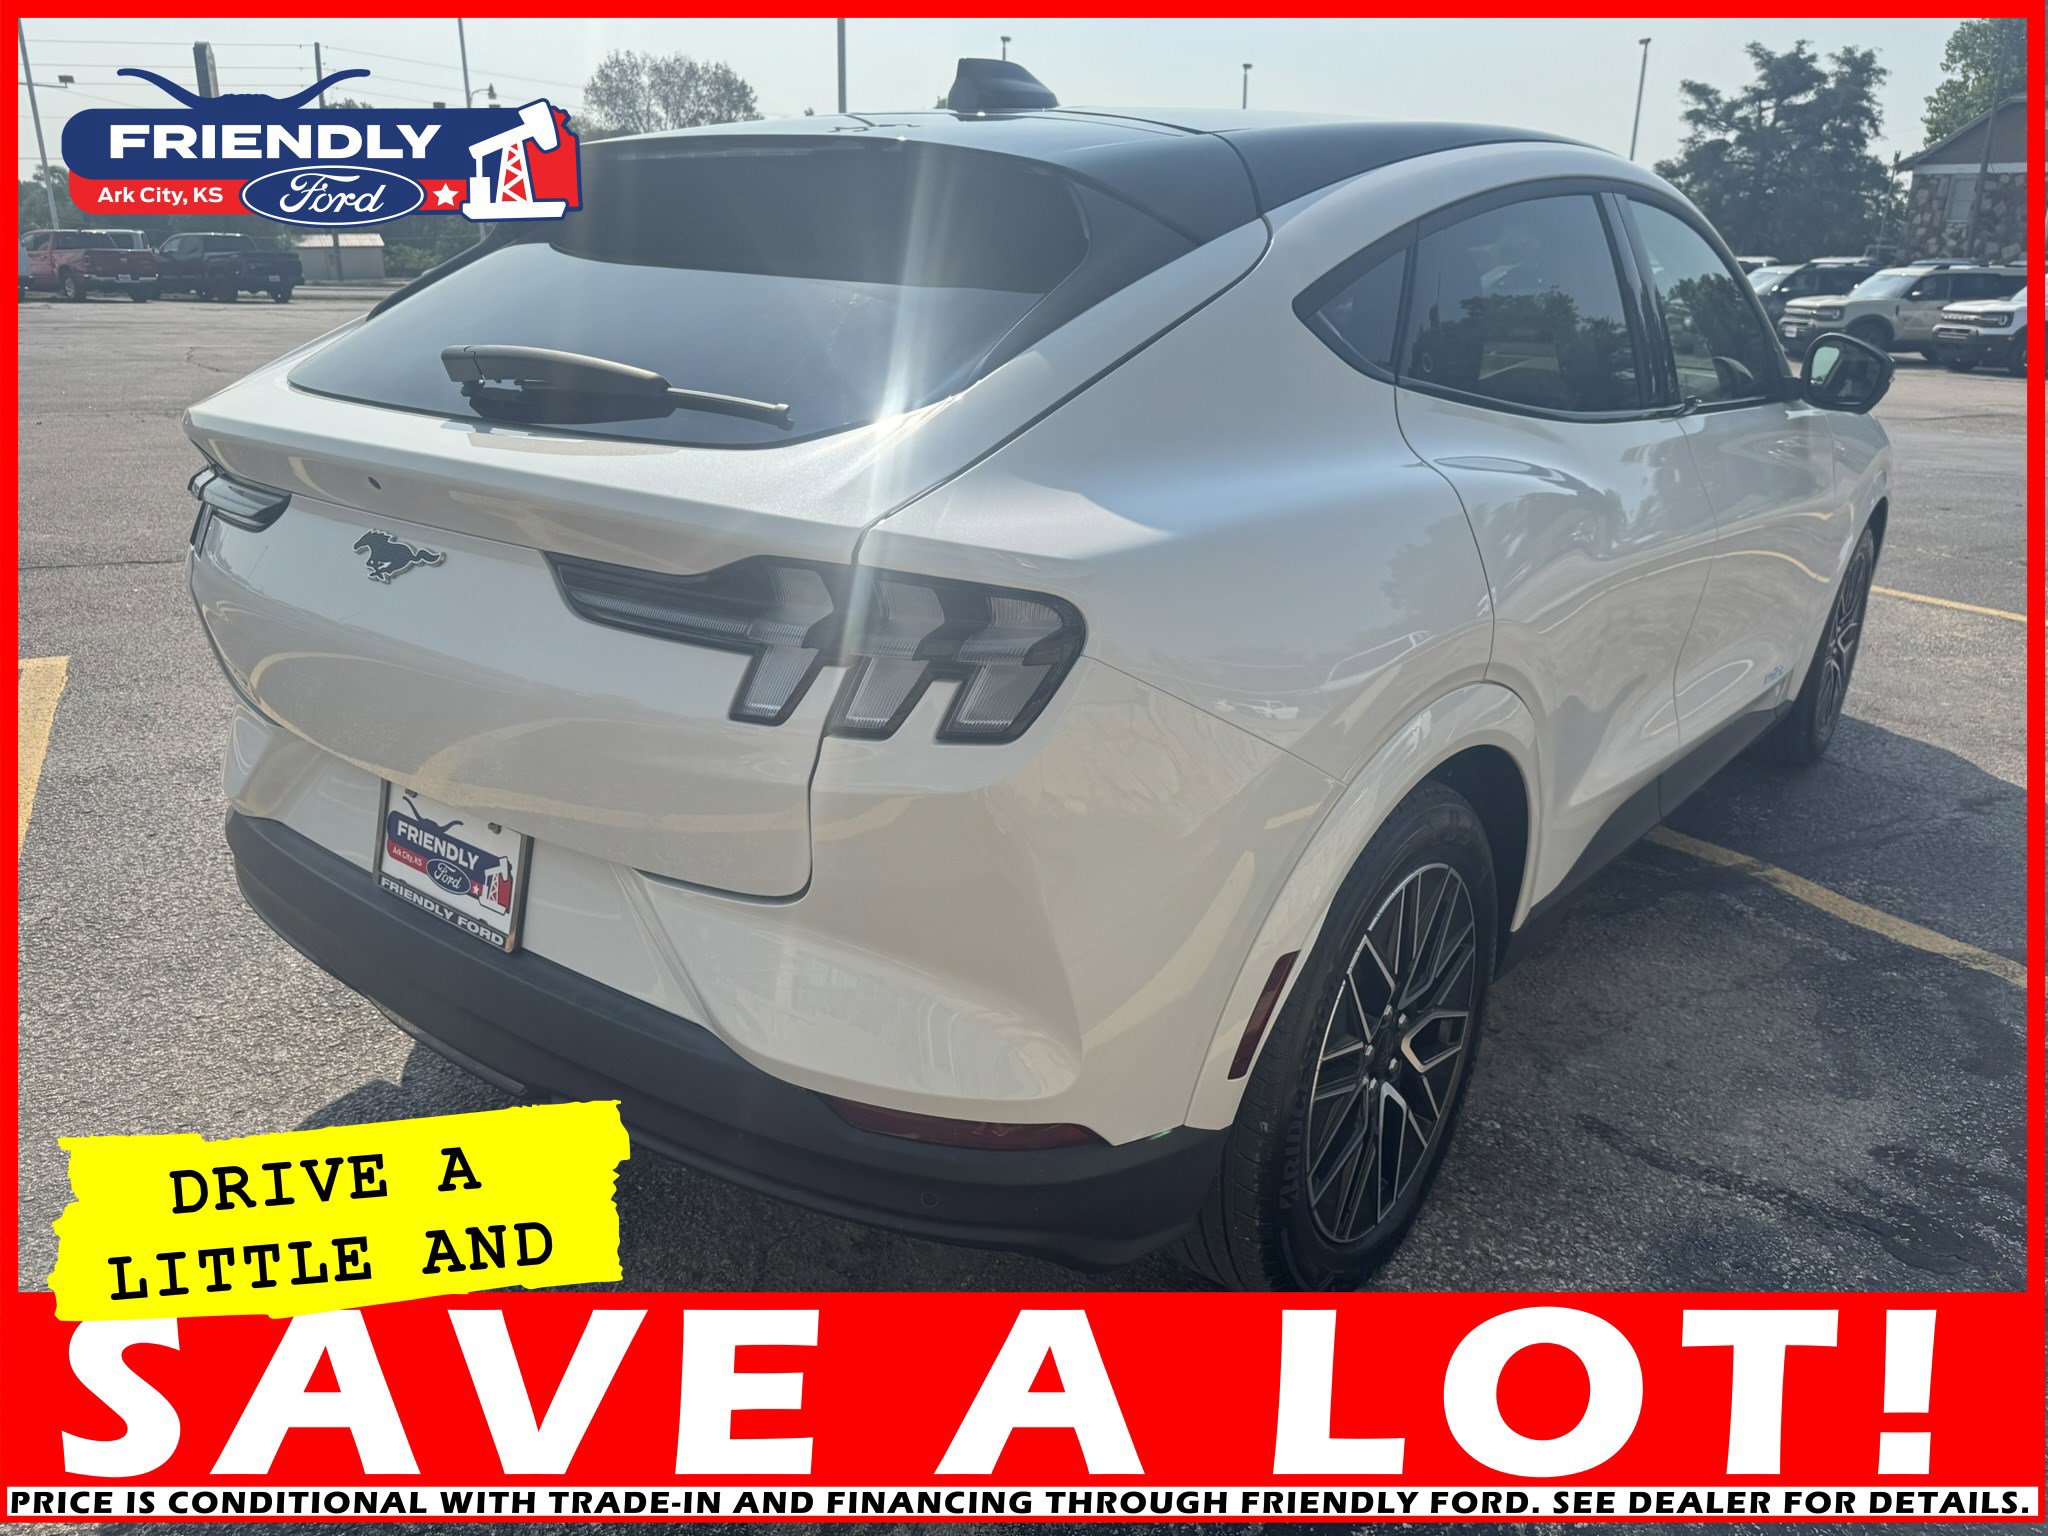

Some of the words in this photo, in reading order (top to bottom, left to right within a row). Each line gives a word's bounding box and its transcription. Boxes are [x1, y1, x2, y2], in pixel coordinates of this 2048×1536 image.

[397, 820, 479, 870] FRIENDLY
[434, 862, 462, 889] Ford
[381, 877, 454, 920] FRIENDLY
[457, 915, 504, 945] FORD
